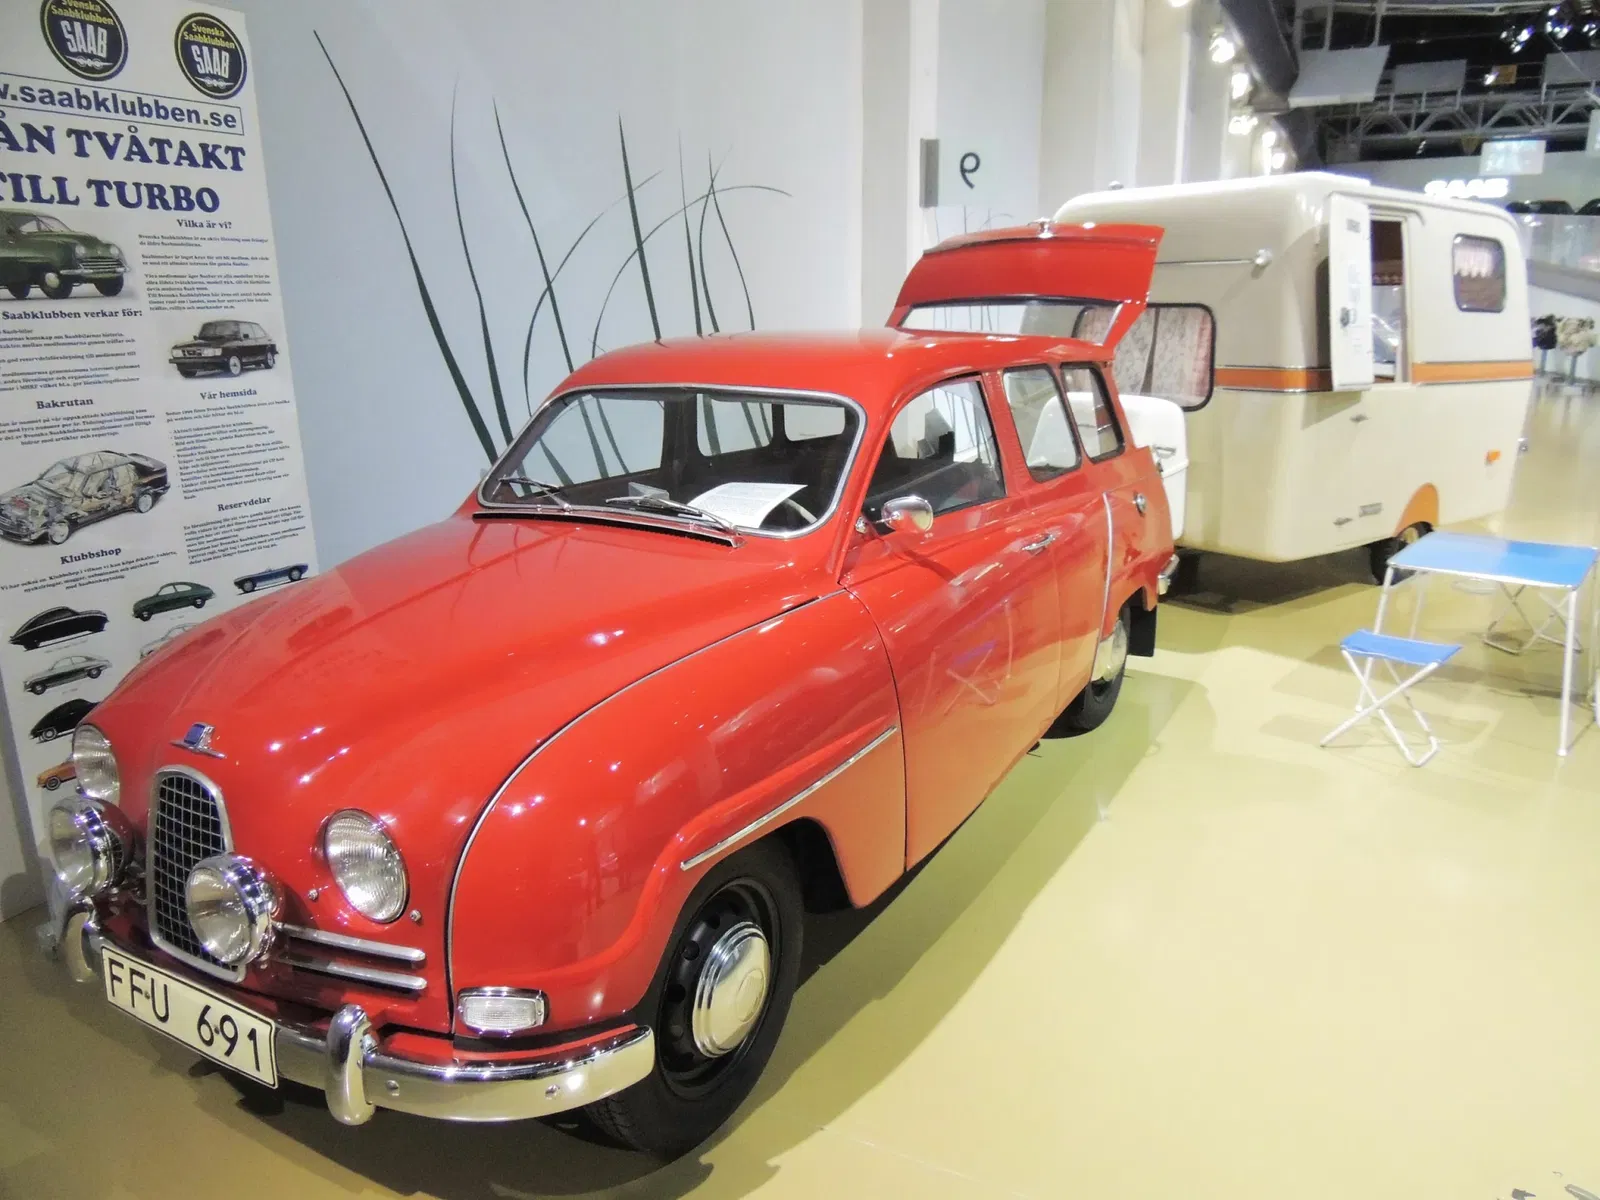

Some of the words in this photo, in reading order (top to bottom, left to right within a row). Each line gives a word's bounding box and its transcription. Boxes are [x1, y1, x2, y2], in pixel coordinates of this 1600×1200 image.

[51, 4, 114, 25] Saabklubben
[61, 0, 101, 12] Svenska
[191, 22, 225, 37] Svenska
[60, 20, 107, 58] SAAB
[183, 31, 235, 49] Saabklubben
[191, 45, 230, 78] SAAB
[66, 125, 246, 171] TVÅTAKT
[86, 178, 220, 213] TURBO
[176, 219, 204, 229] Vilka
[205, 220, 217, 229] är
[218, 221, 232, 229] vi?
[2, 310, 82, 320] Saabklubben
[84, 309, 119, 318] verkar
[122, 308, 143, 318] för:
[36, 397, 94, 410] Bakrutan
[199, 391, 217, 401] Vår
[219, 388, 257, 399] hemsida
[217, 496, 271, 512] Reservdelar
[60, 547, 122, 565] Klubbshop
[107, 957, 170, 1024] FFU
[196, 1003, 261, 1073] 691
